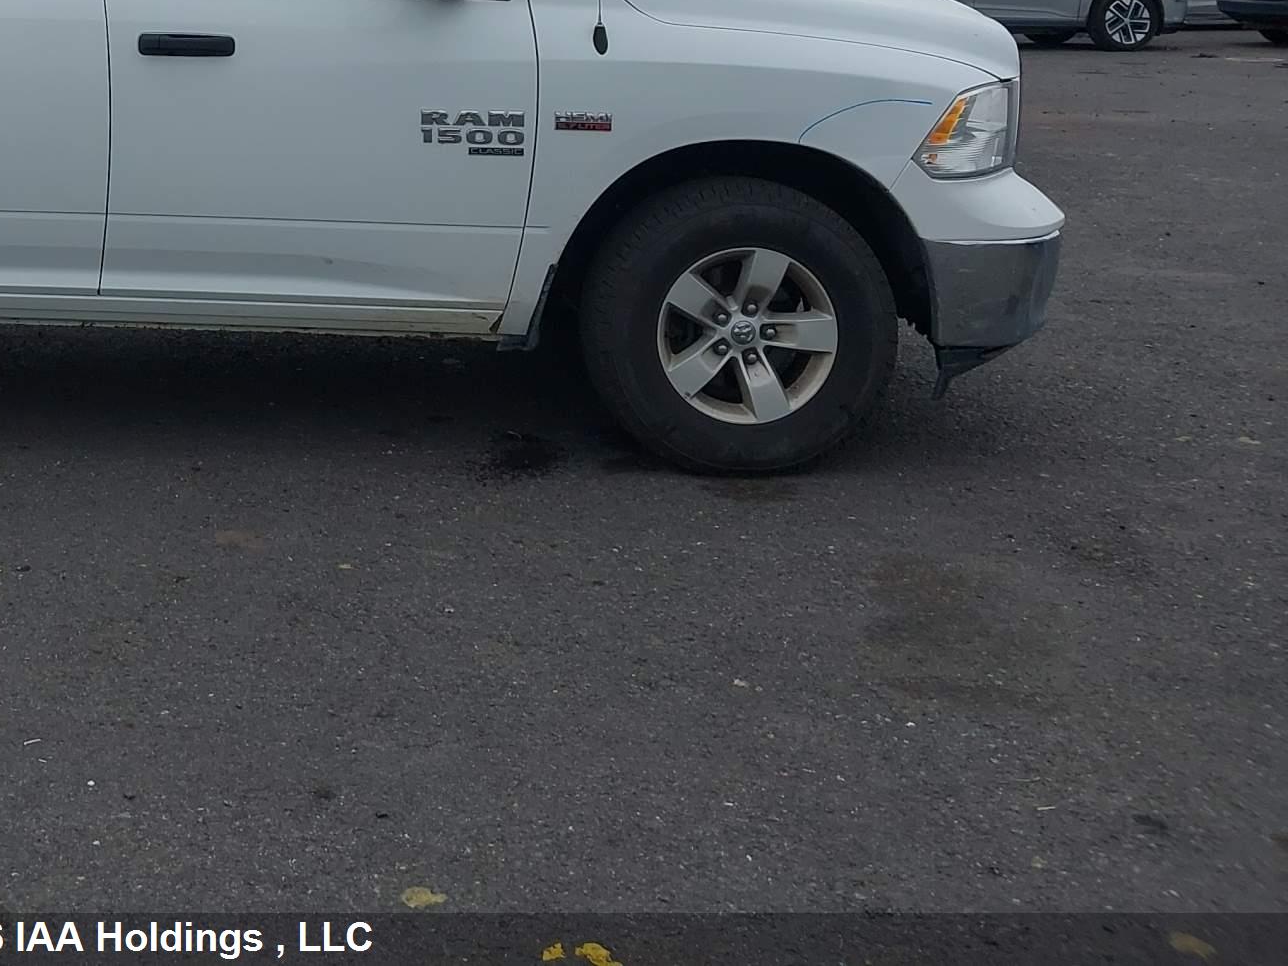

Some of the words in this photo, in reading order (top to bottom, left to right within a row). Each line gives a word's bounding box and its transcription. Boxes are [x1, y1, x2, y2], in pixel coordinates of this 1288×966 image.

[420, 109, 525, 127] RAM
[554, 111, 612, 123] HEMI
[420, 127, 525, 146] 1500
[469, 147, 524, 155] CLASSIC
